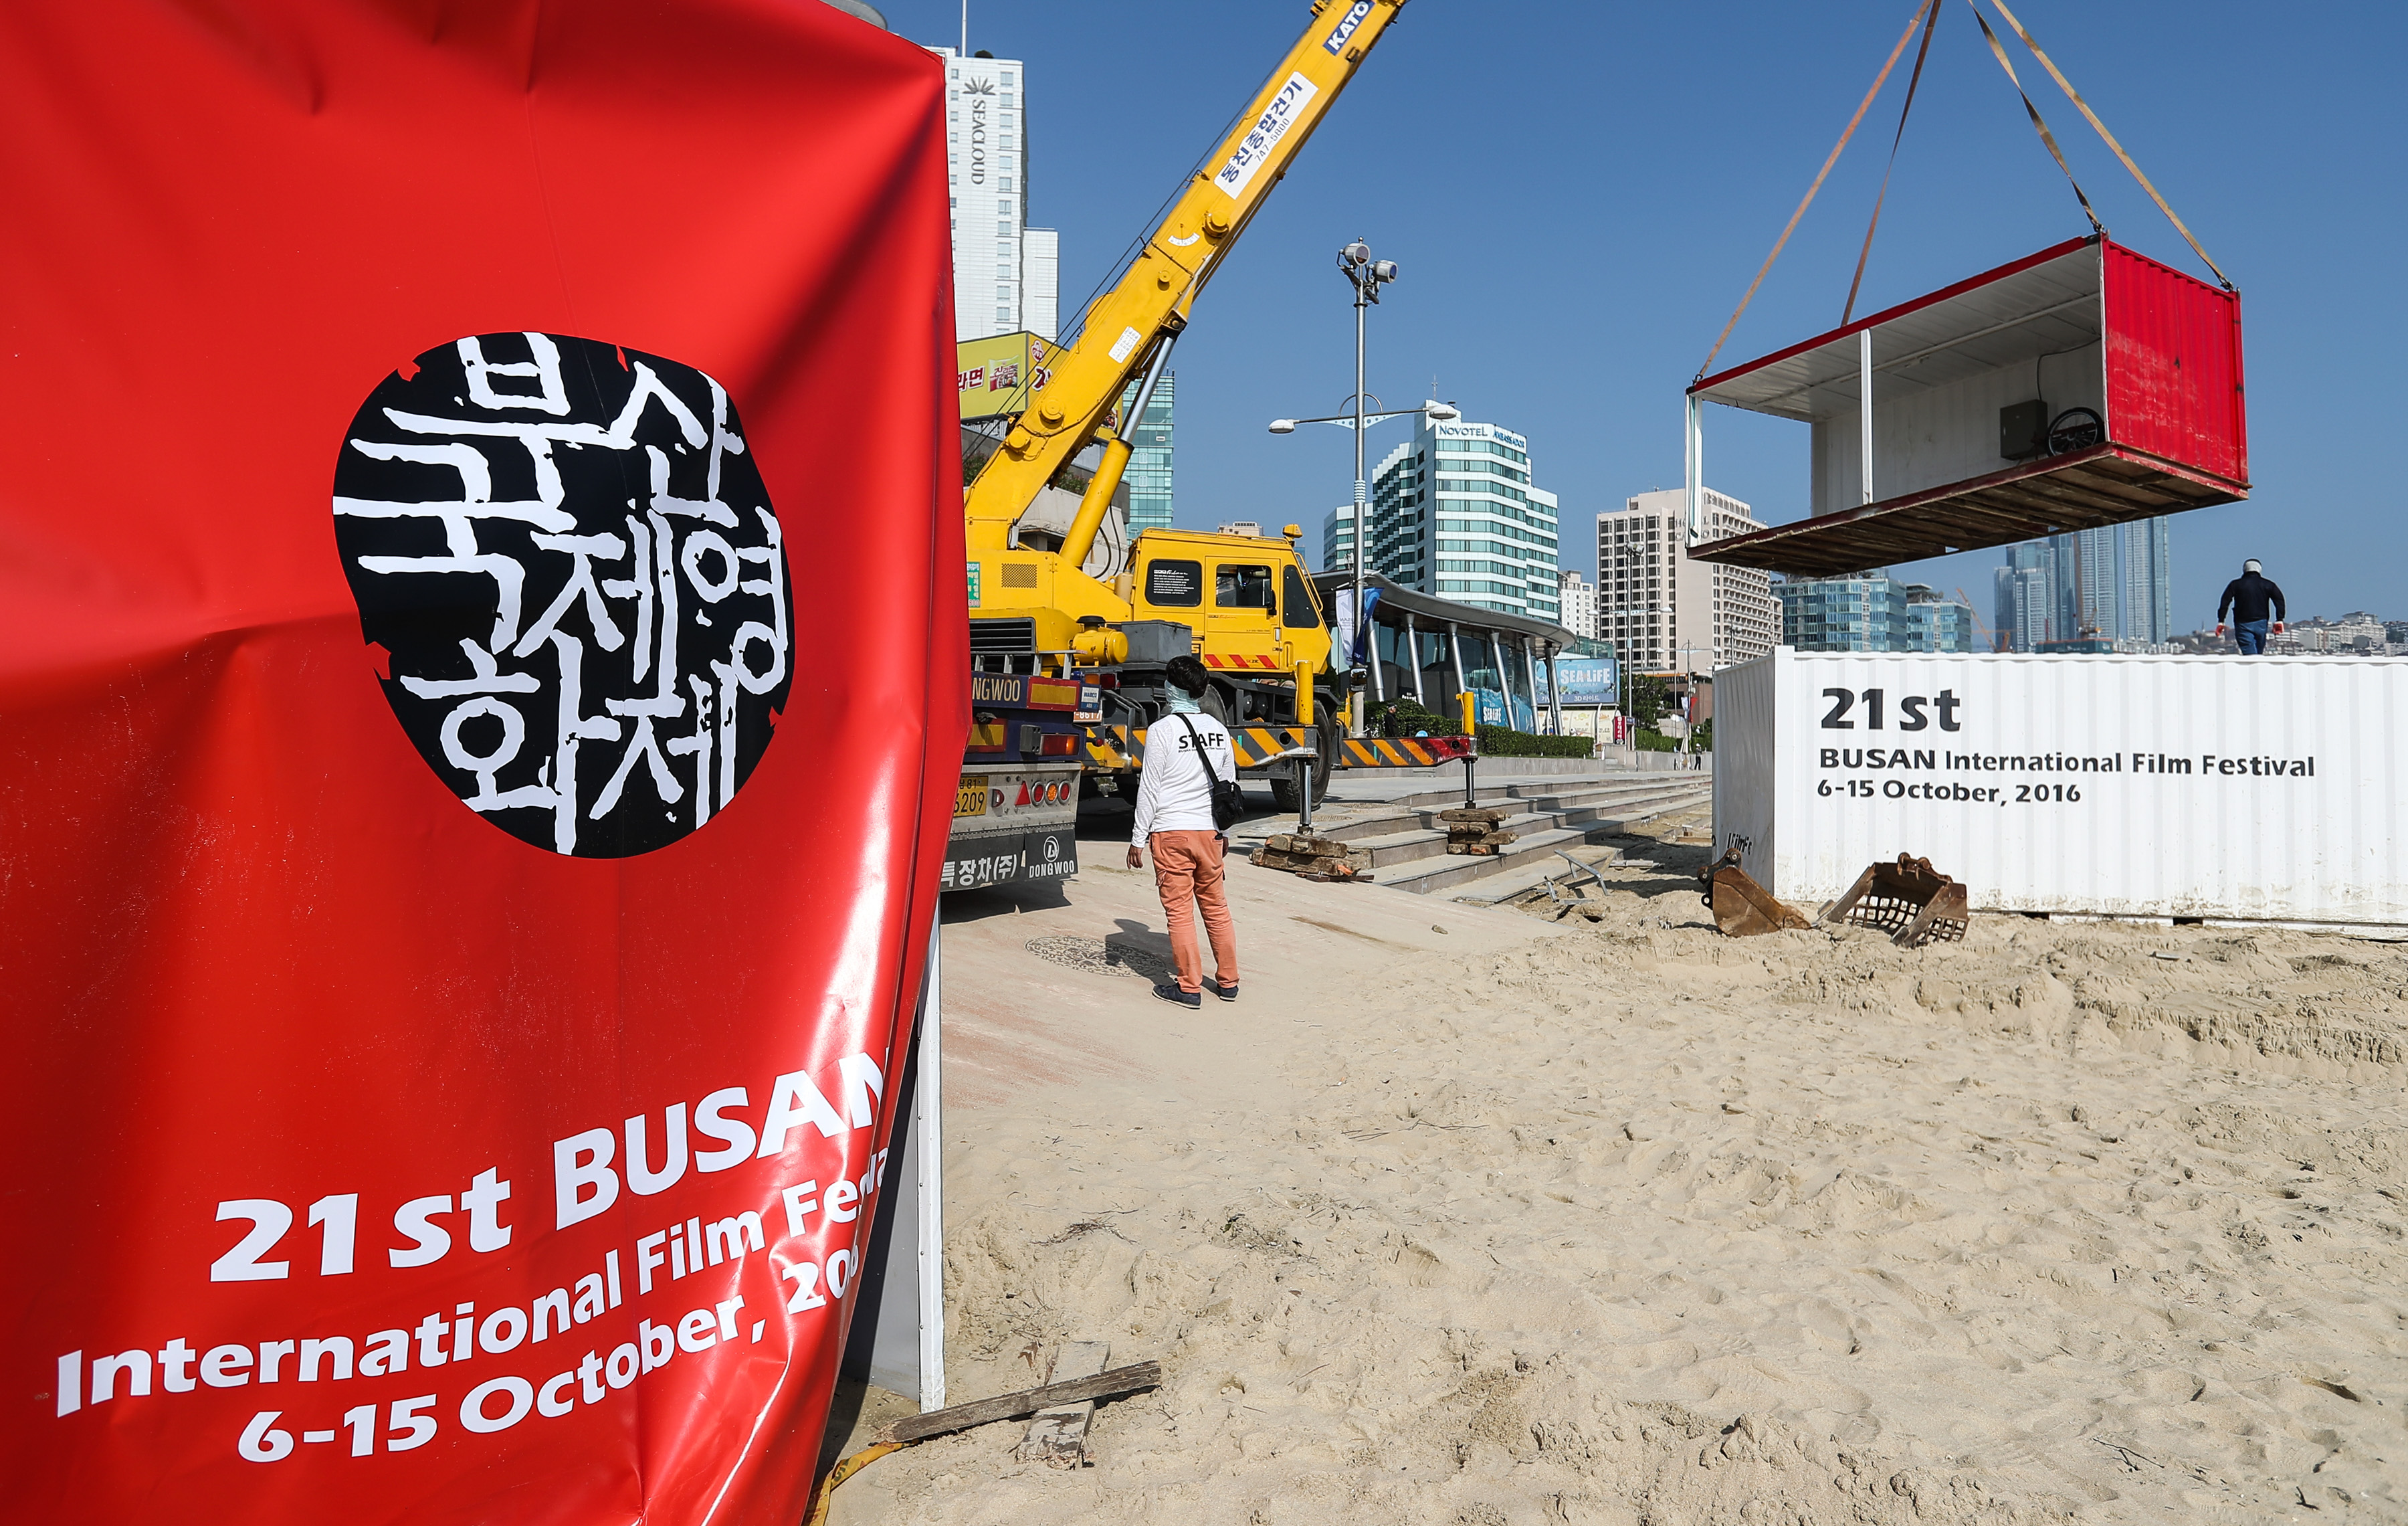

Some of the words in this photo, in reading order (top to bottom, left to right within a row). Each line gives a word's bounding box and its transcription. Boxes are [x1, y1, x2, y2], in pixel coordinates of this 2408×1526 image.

[1327, 1, 1369, 50] KATO
[971, 99, 986, 185] SEACLOUD
[1221, 80, 1303, 183] 동진종합건기
[1254, 118, 1290, 162] 747-5800
[1439, 425, 1488, 436] NOVOTEL
[972, 677, 1021, 702] NGWOO
[1561, 670, 1584, 684] SEA
[1074, 711, 1101, 719] -8617
[1179, 733, 1224, 749] STAFF
[1820, 749, 1935, 769] BUSAN
[1946, 751, 2121, 772] International
[2132, 753, 2192, 774] Film
[2203, 755, 2314, 777] Festival
[1817, 779, 1874, 797] 6-15
[1883, 780, 2007, 807] October,
[2015, 784, 2080, 802] 2016
[1029, 860, 1074, 878] DONGWOO
[554, 1052, 884, 1230] BUSAN
[58, 1249, 621, 1418] International
[637, 1210, 766, 1295] Film
[238, 1394, 437, 1462] 6-15
[460, 1296, 766, 1433] October,
